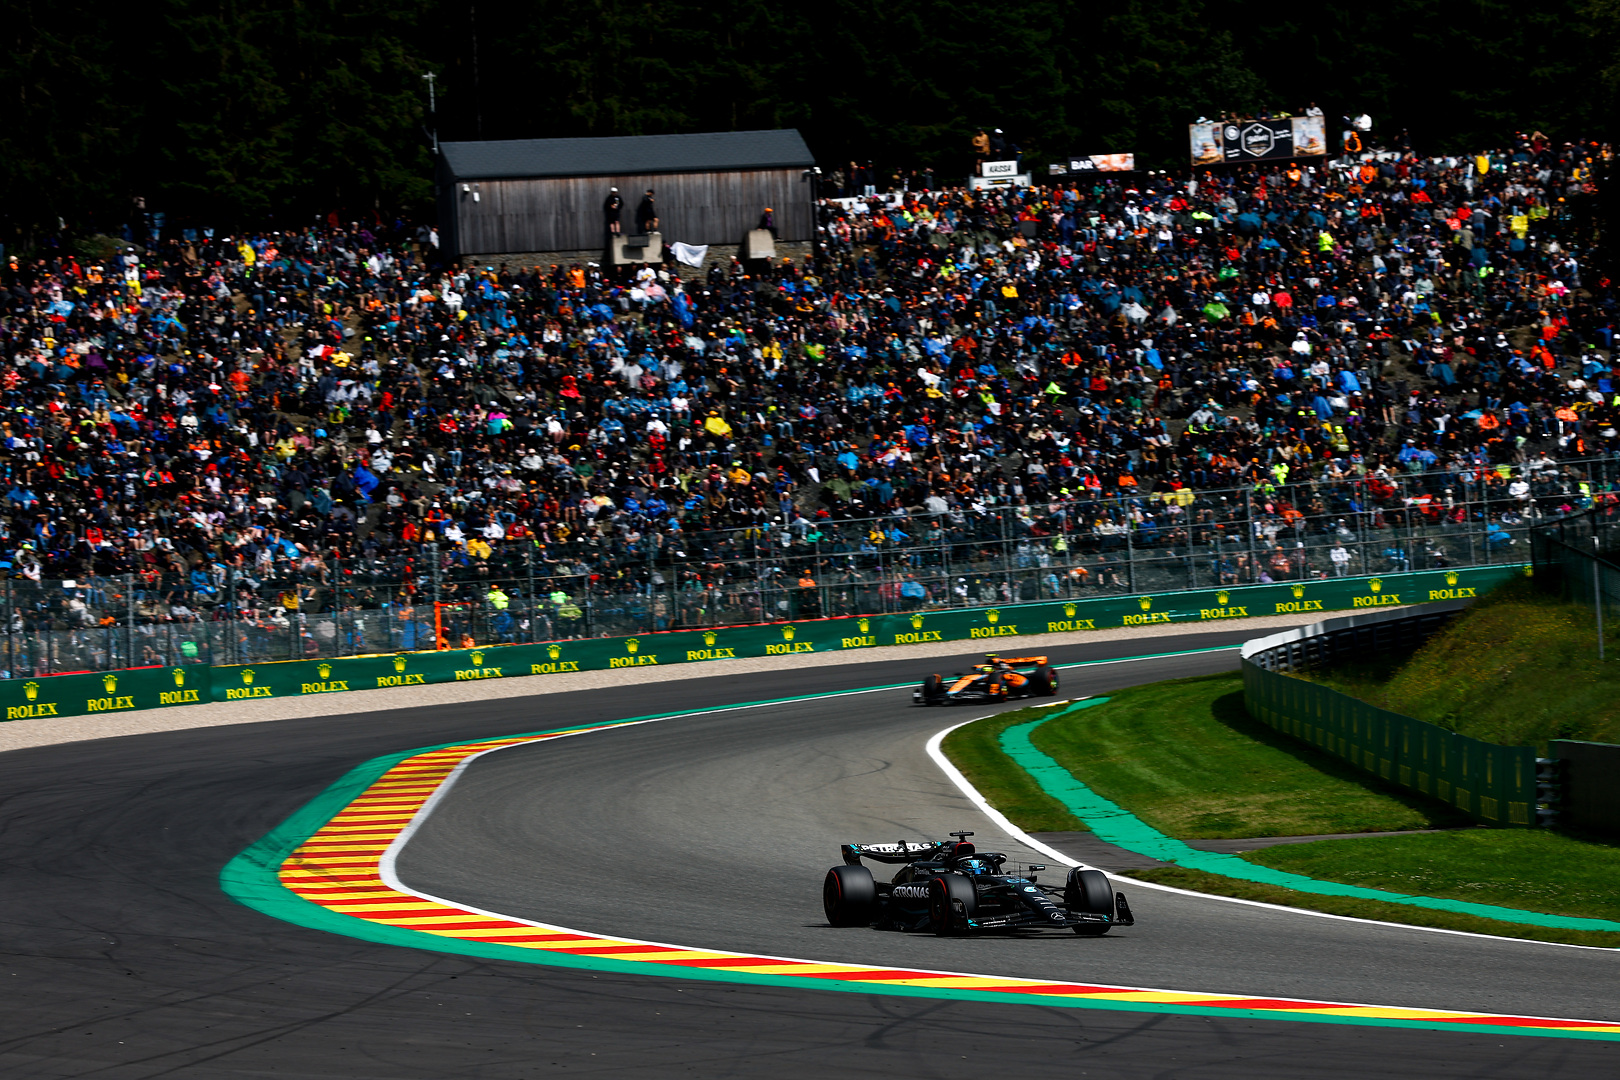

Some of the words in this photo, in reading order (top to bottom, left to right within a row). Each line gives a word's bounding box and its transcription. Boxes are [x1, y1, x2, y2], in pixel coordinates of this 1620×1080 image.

[1071, 160, 1093, 170] BAR
[1429, 588, 1476, 600] ROLEX
[1276, 600, 1323, 612] ROLEX
[1353, 594, 1400, 607] ROLEX
[1123, 613, 1171, 625] ROLEX
[1201, 607, 1248, 619] ROLEX
[971, 625, 1018, 638] ROLEX
[1048, 619, 1095, 632] ROLEX
[842, 636, 876, 648] ROL
[895, 631, 942, 643] ROLEX
[766, 642, 813, 654] ROLEX
[687, 648, 735, 661] ROLEX
[531, 661, 579, 674] ROLEX
[610, 655, 657, 668] ROLEX
[377, 674, 425, 686] ROLEX
[455, 668, 503, 680] ROLEX
[226, 687, 272, 699] ROLEX
[302, 681, 349, 693] ROLEX
[160, 690, 199, 704] ROLEX
[87, 696, 134, 711] ROLEX
[7, 703, 58, 719] ROLEX
